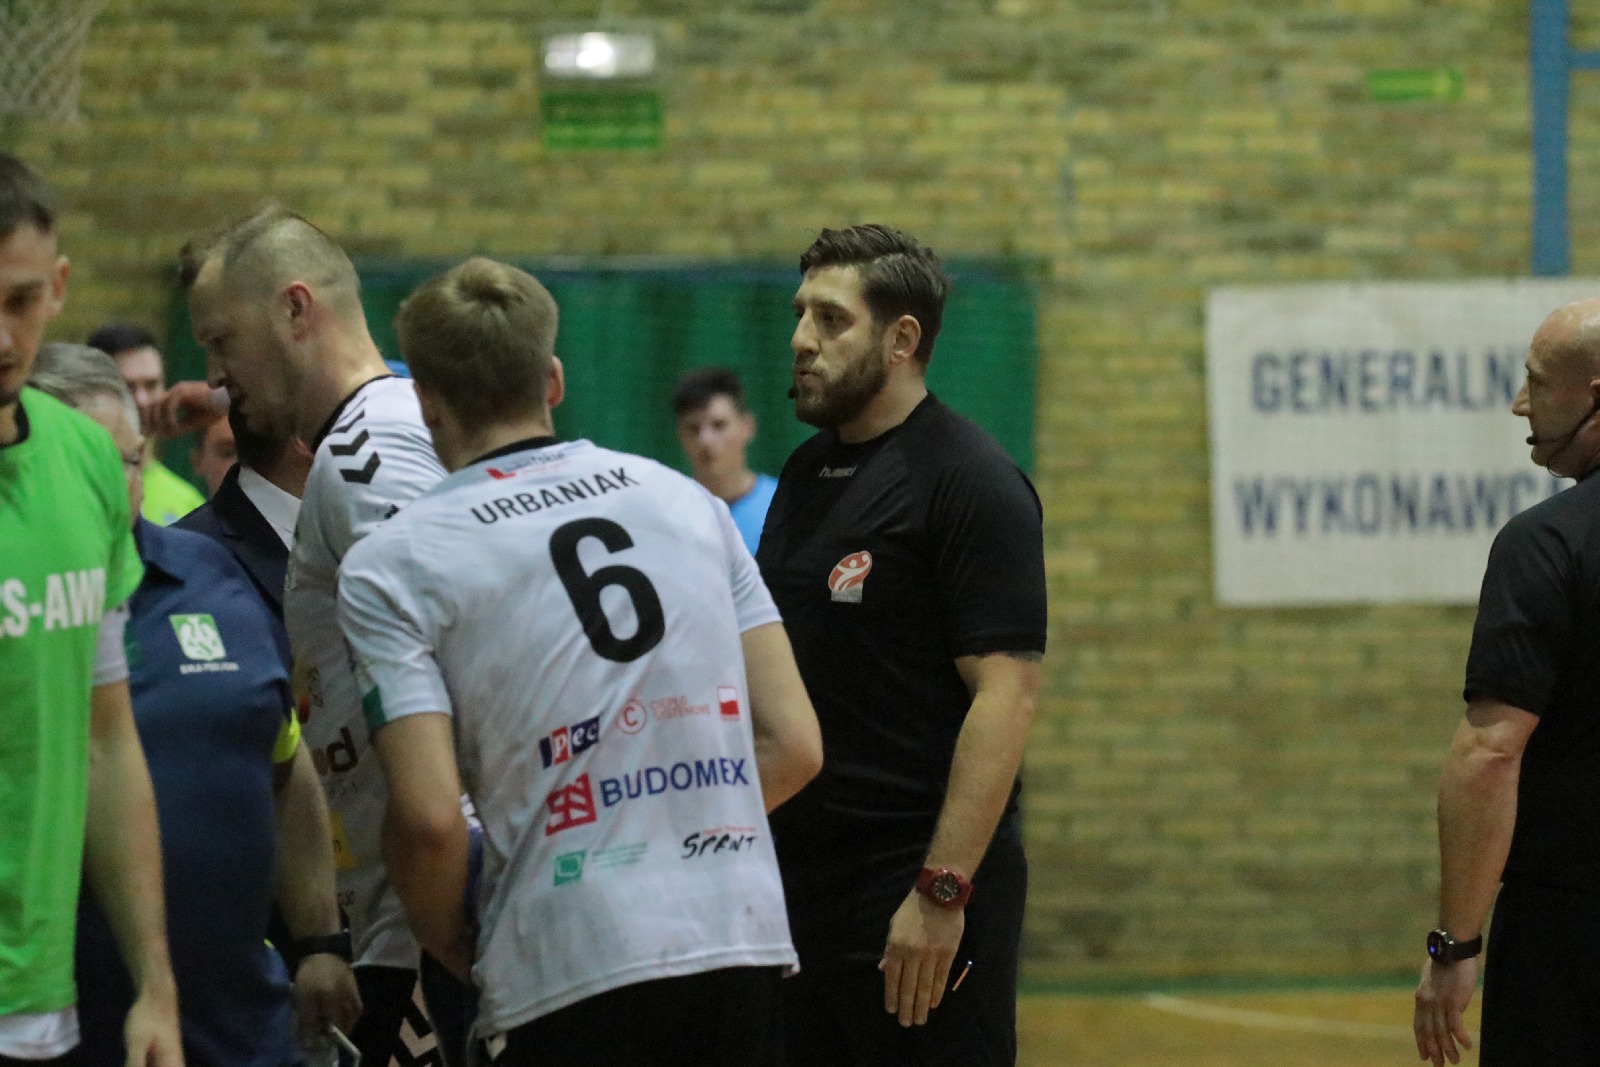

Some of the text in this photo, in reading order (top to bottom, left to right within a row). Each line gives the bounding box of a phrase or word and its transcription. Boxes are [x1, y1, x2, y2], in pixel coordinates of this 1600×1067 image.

[1251, 346, 1526, 413] GENERALN
[470, 467, 639, 524] URBANIAK
[549, 517, 665, 663] 6
[600, 758, 749, 807] BUDOMEX
